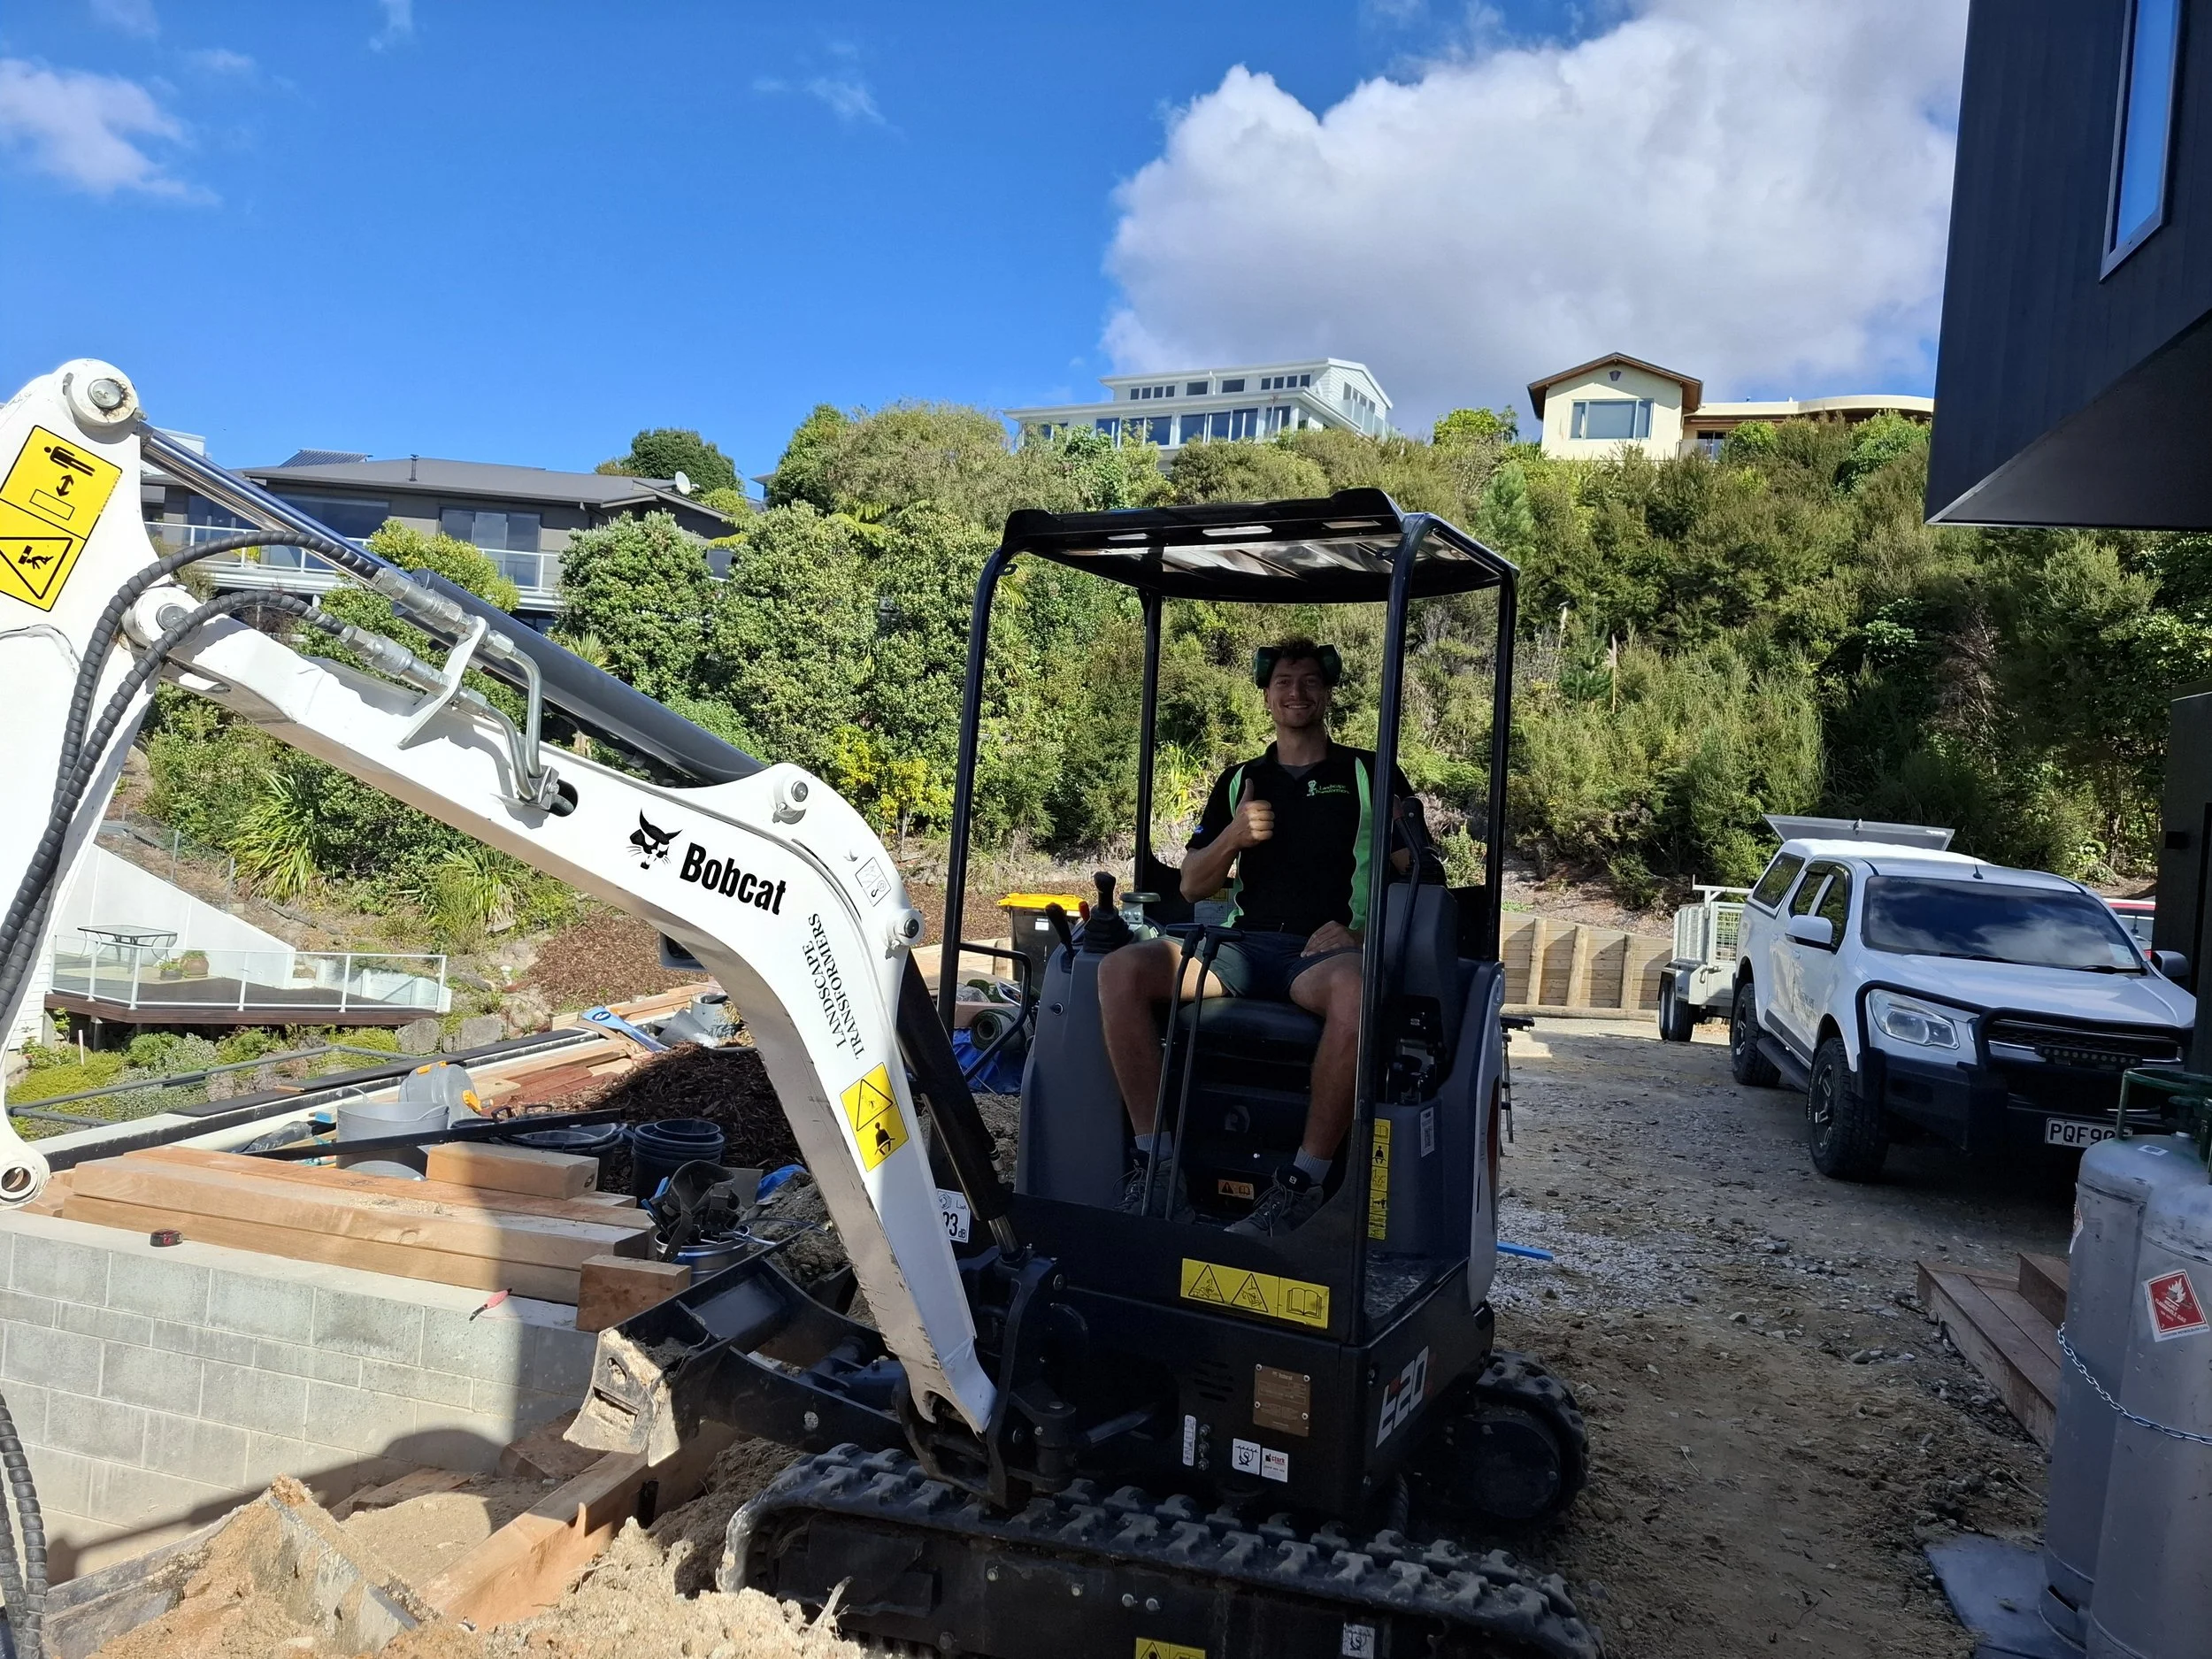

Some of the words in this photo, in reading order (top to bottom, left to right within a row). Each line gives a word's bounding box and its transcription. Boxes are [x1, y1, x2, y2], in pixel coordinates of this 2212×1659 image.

[680, 842, 787, 916] Bobcat
[802, 941, 848, 1048] LANDSCAPE
[808, 913, 865, 1060] TRANSFORMERS
[2050, 1123, 2129, 1146] PQF90
[958, 1228, 966, 1239] dB
